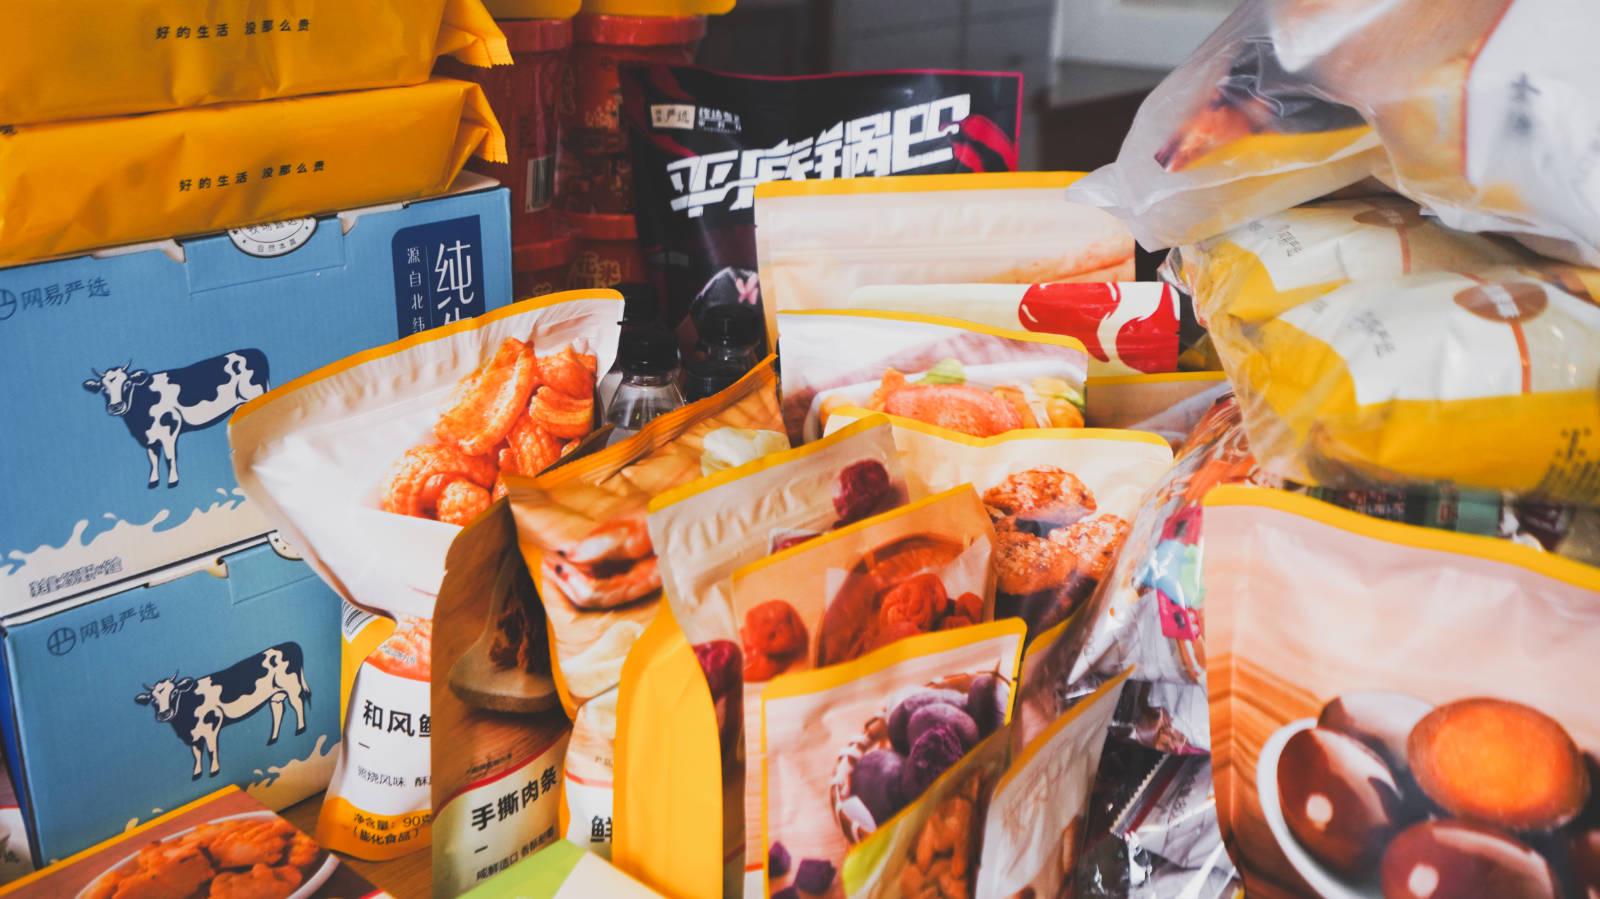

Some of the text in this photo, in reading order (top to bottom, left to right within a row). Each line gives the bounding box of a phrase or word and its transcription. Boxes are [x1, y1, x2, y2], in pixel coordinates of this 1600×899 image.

[155, 18, 310, 40] 好的生活 没那么贵
[178, 159, 326, 192] 好的生活 没那么贵
[21, 275, 112, 310] 网易严选
[79, 601, 161, 644] 网易严选
[471, 766, 557, 831] 手撕肉条
